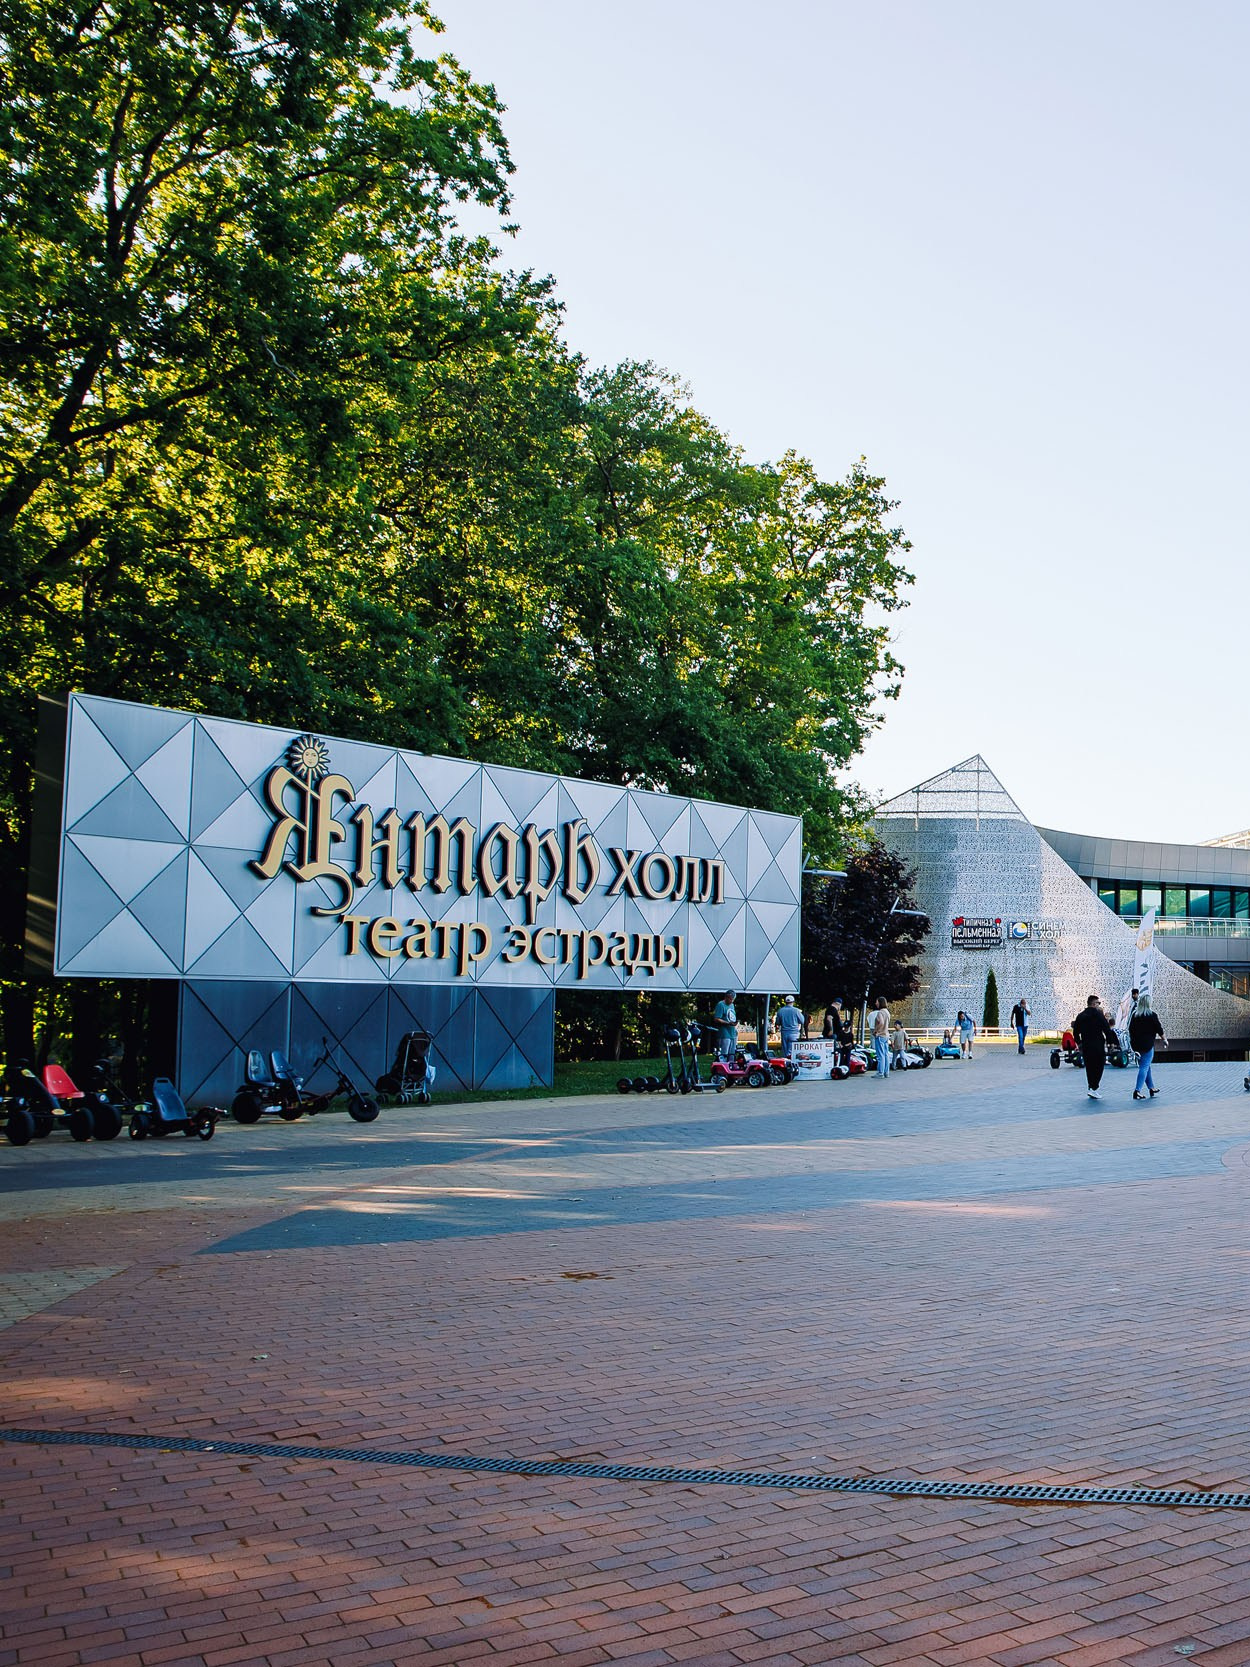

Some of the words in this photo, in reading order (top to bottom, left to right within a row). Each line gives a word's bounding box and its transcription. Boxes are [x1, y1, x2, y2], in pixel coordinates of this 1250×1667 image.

[250, 764, 600, 924] Янтарь
[608, 847, 726, 904] холл
[341, 914, 493, 977] театр
[502, 925, 685, 979] эстрады
[1032, 922, 1068, 930] СИНЕМ
